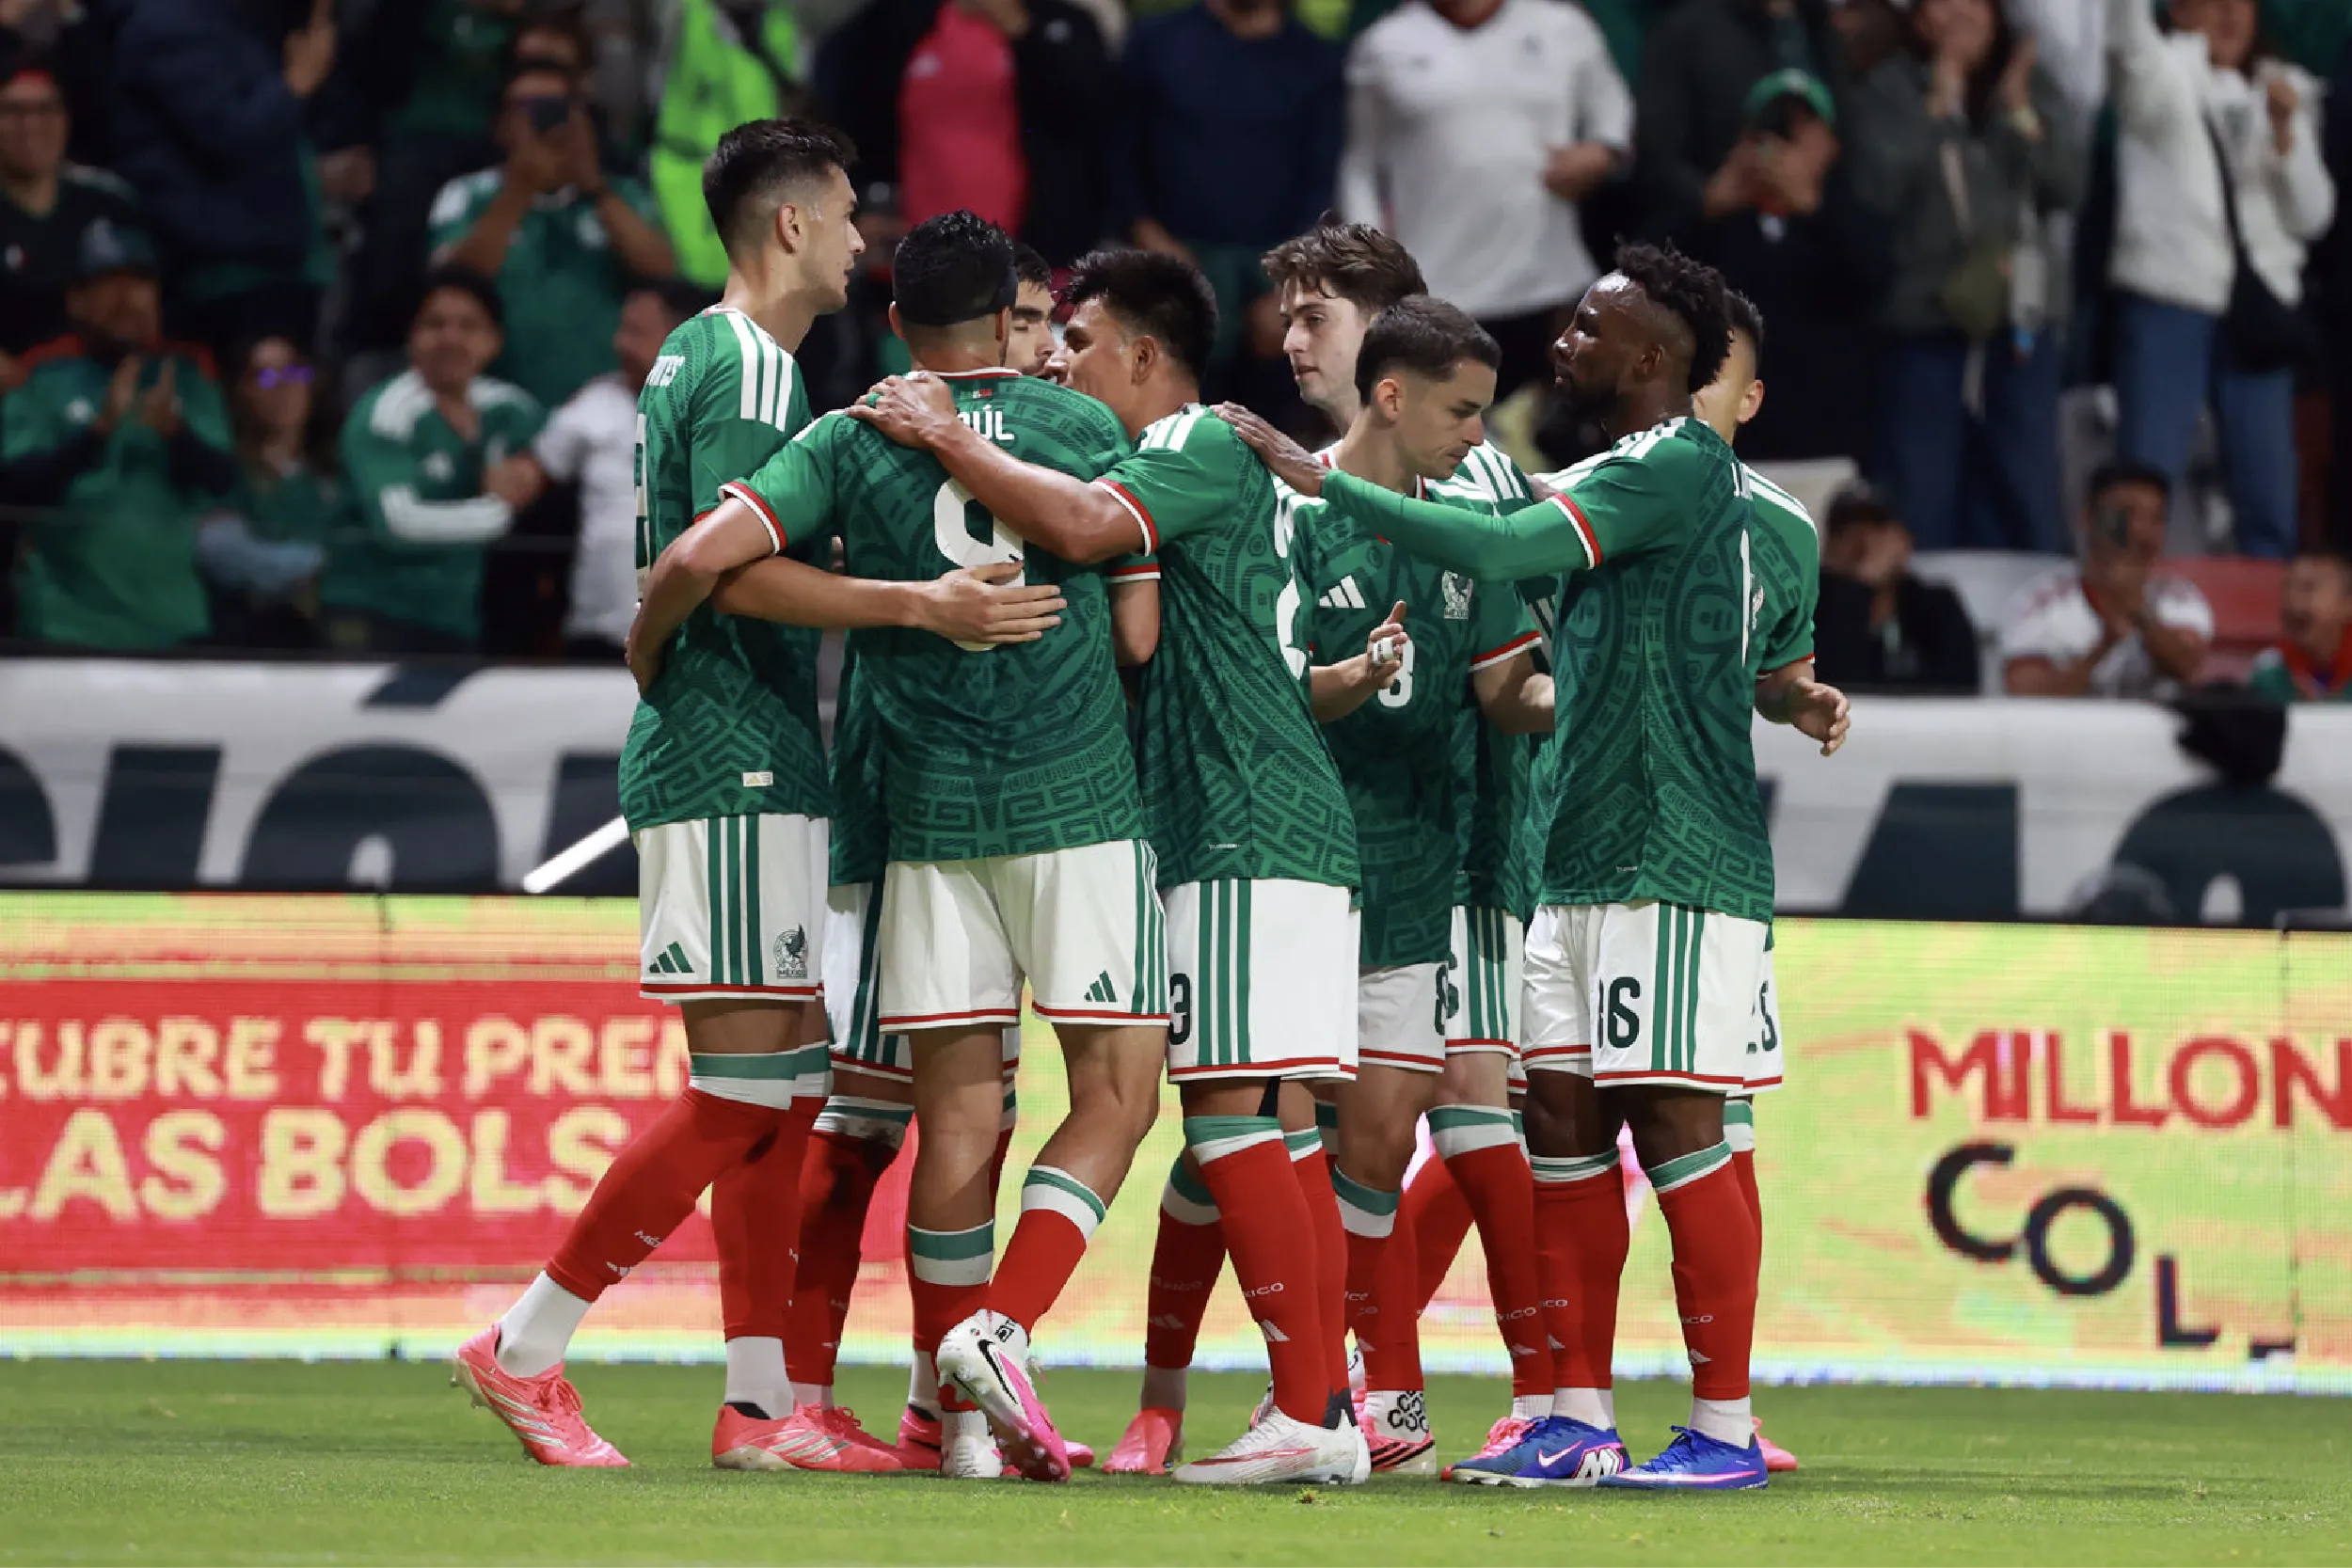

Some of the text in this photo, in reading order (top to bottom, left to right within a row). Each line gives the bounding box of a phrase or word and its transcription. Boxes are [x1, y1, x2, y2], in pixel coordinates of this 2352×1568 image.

[0, 1016, 280, 1101] UBRE
[305, 1016, 443, 1101] TU
[260, 1104, 631, 1220] BOLS
[1925, 1137, 2296, 1361] COL
